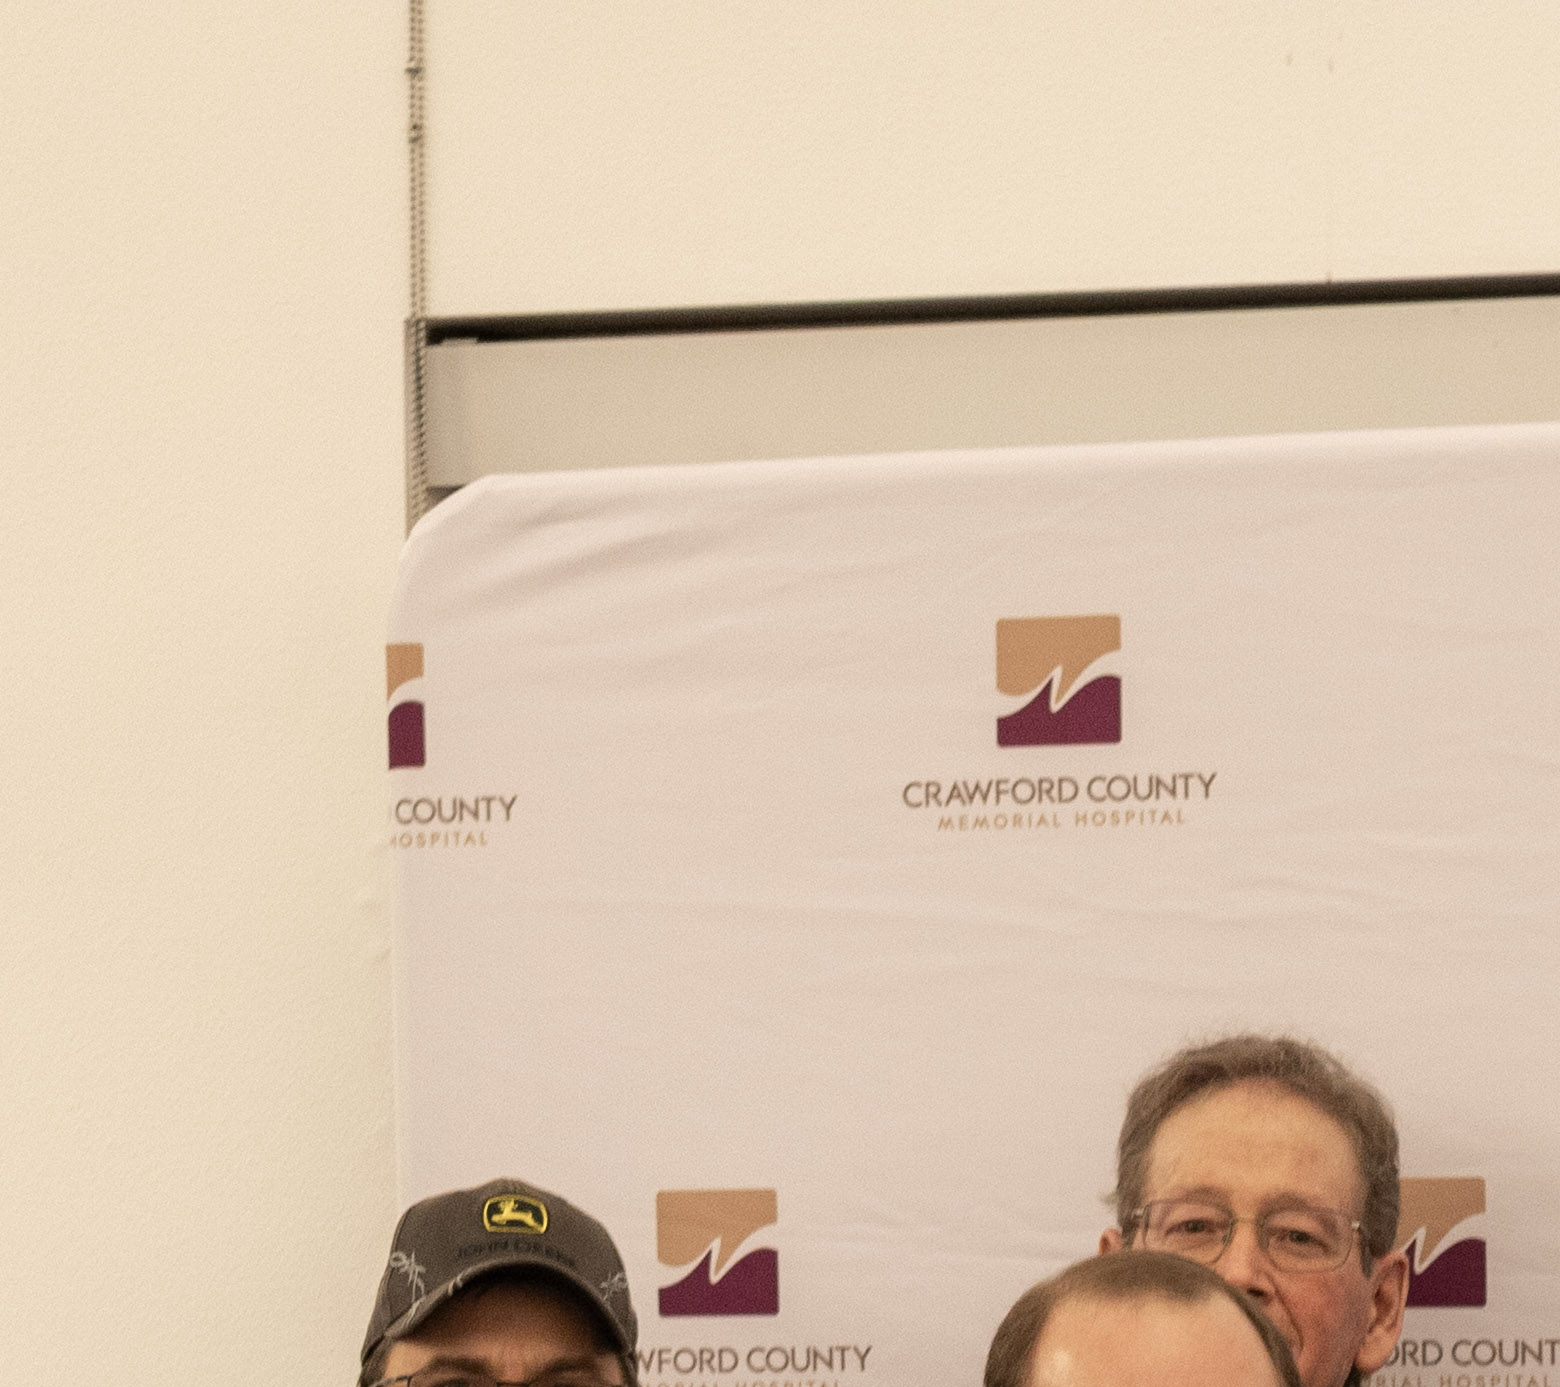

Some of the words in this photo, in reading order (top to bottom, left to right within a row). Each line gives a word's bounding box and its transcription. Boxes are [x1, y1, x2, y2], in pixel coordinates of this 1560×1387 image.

[902, 777, 1080, 808] CRAWFORD
[1087, 772, 1217, 803] COUNTY
[395, 795, 518, 825] COUNTY
[938, 812, 1061, 832] MEMORIAL
[1074, 808, 1185, 828] HOSPITAL
[746, 1344, 872, 1373] COUNTY
